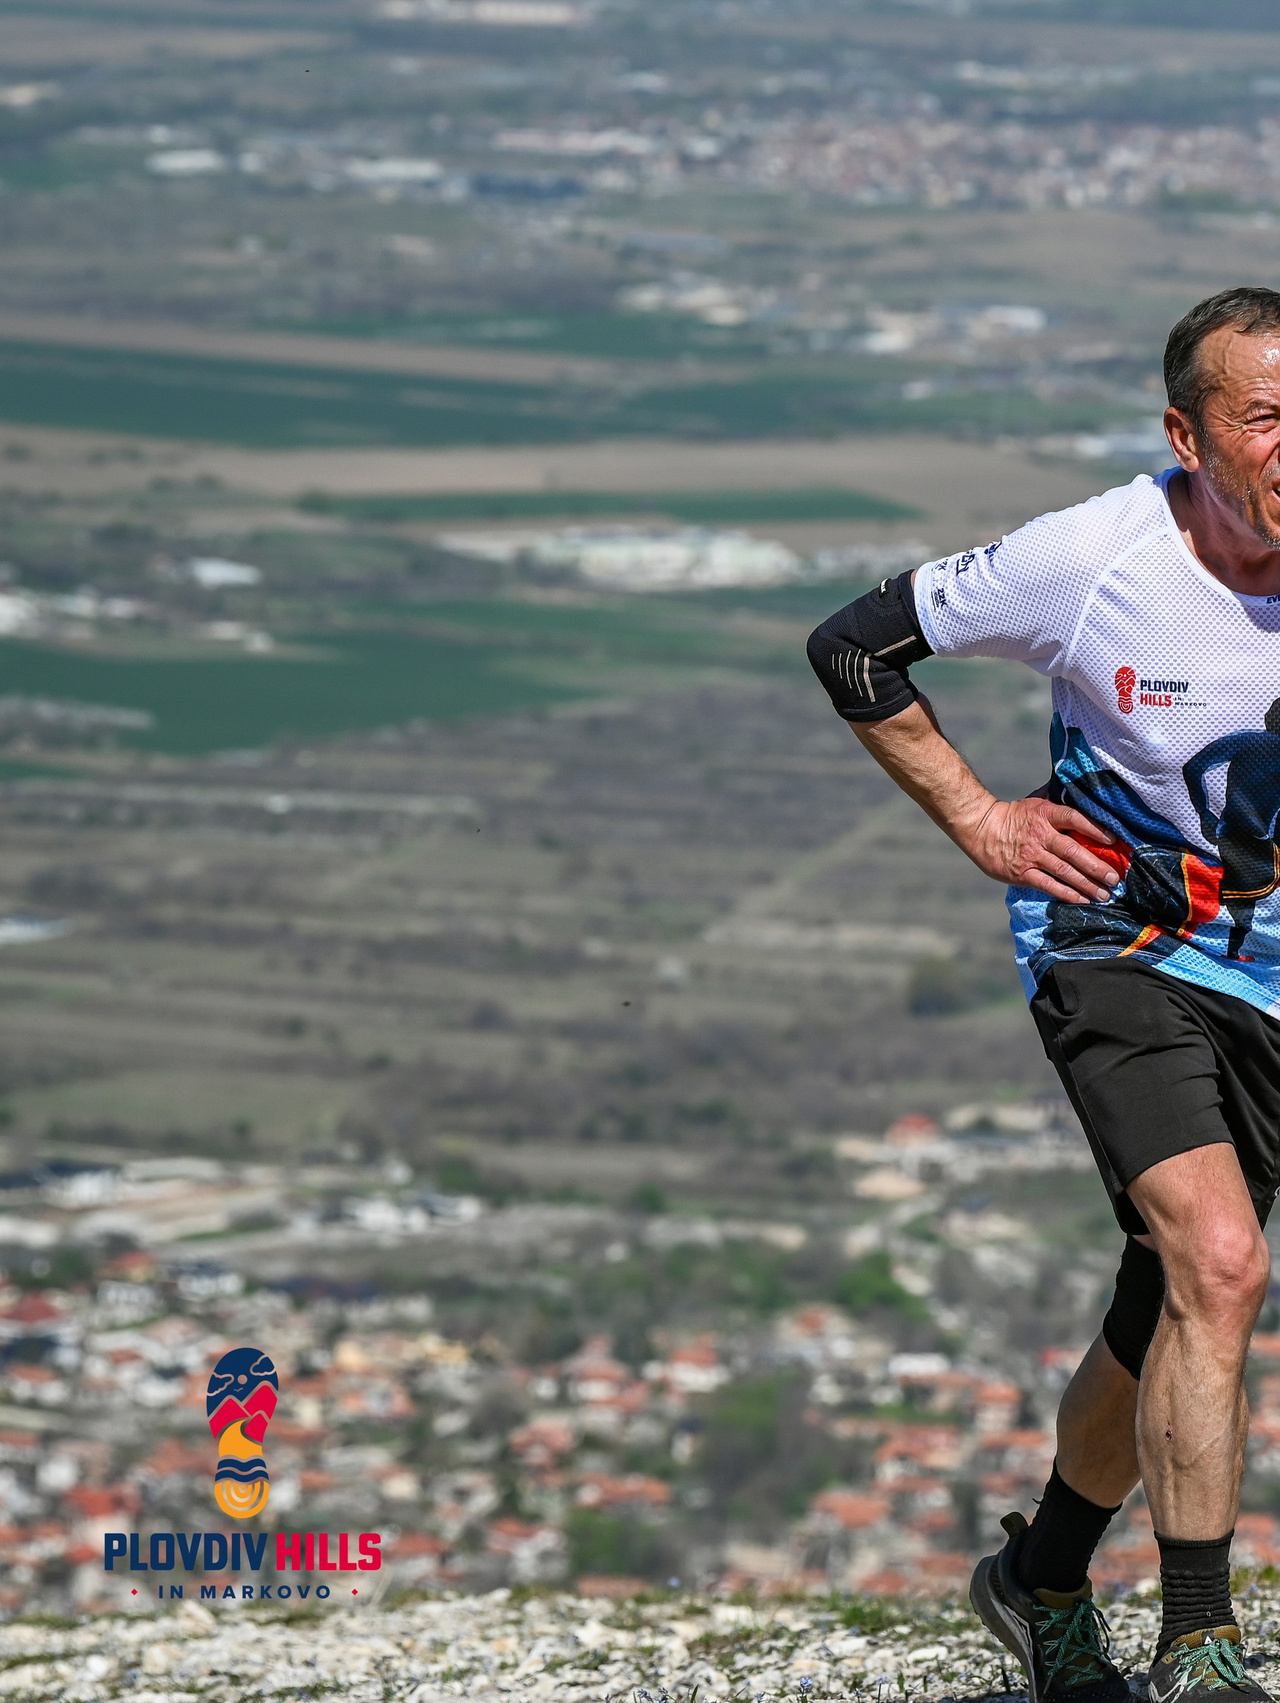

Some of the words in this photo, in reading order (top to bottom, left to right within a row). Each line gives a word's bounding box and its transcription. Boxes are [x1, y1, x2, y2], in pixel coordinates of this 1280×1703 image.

[937, 588, 949, 609] 22K
[1140, 680, 1189, 693] PLOVDIV
[1140, 693, 1172, 707] HILLS
